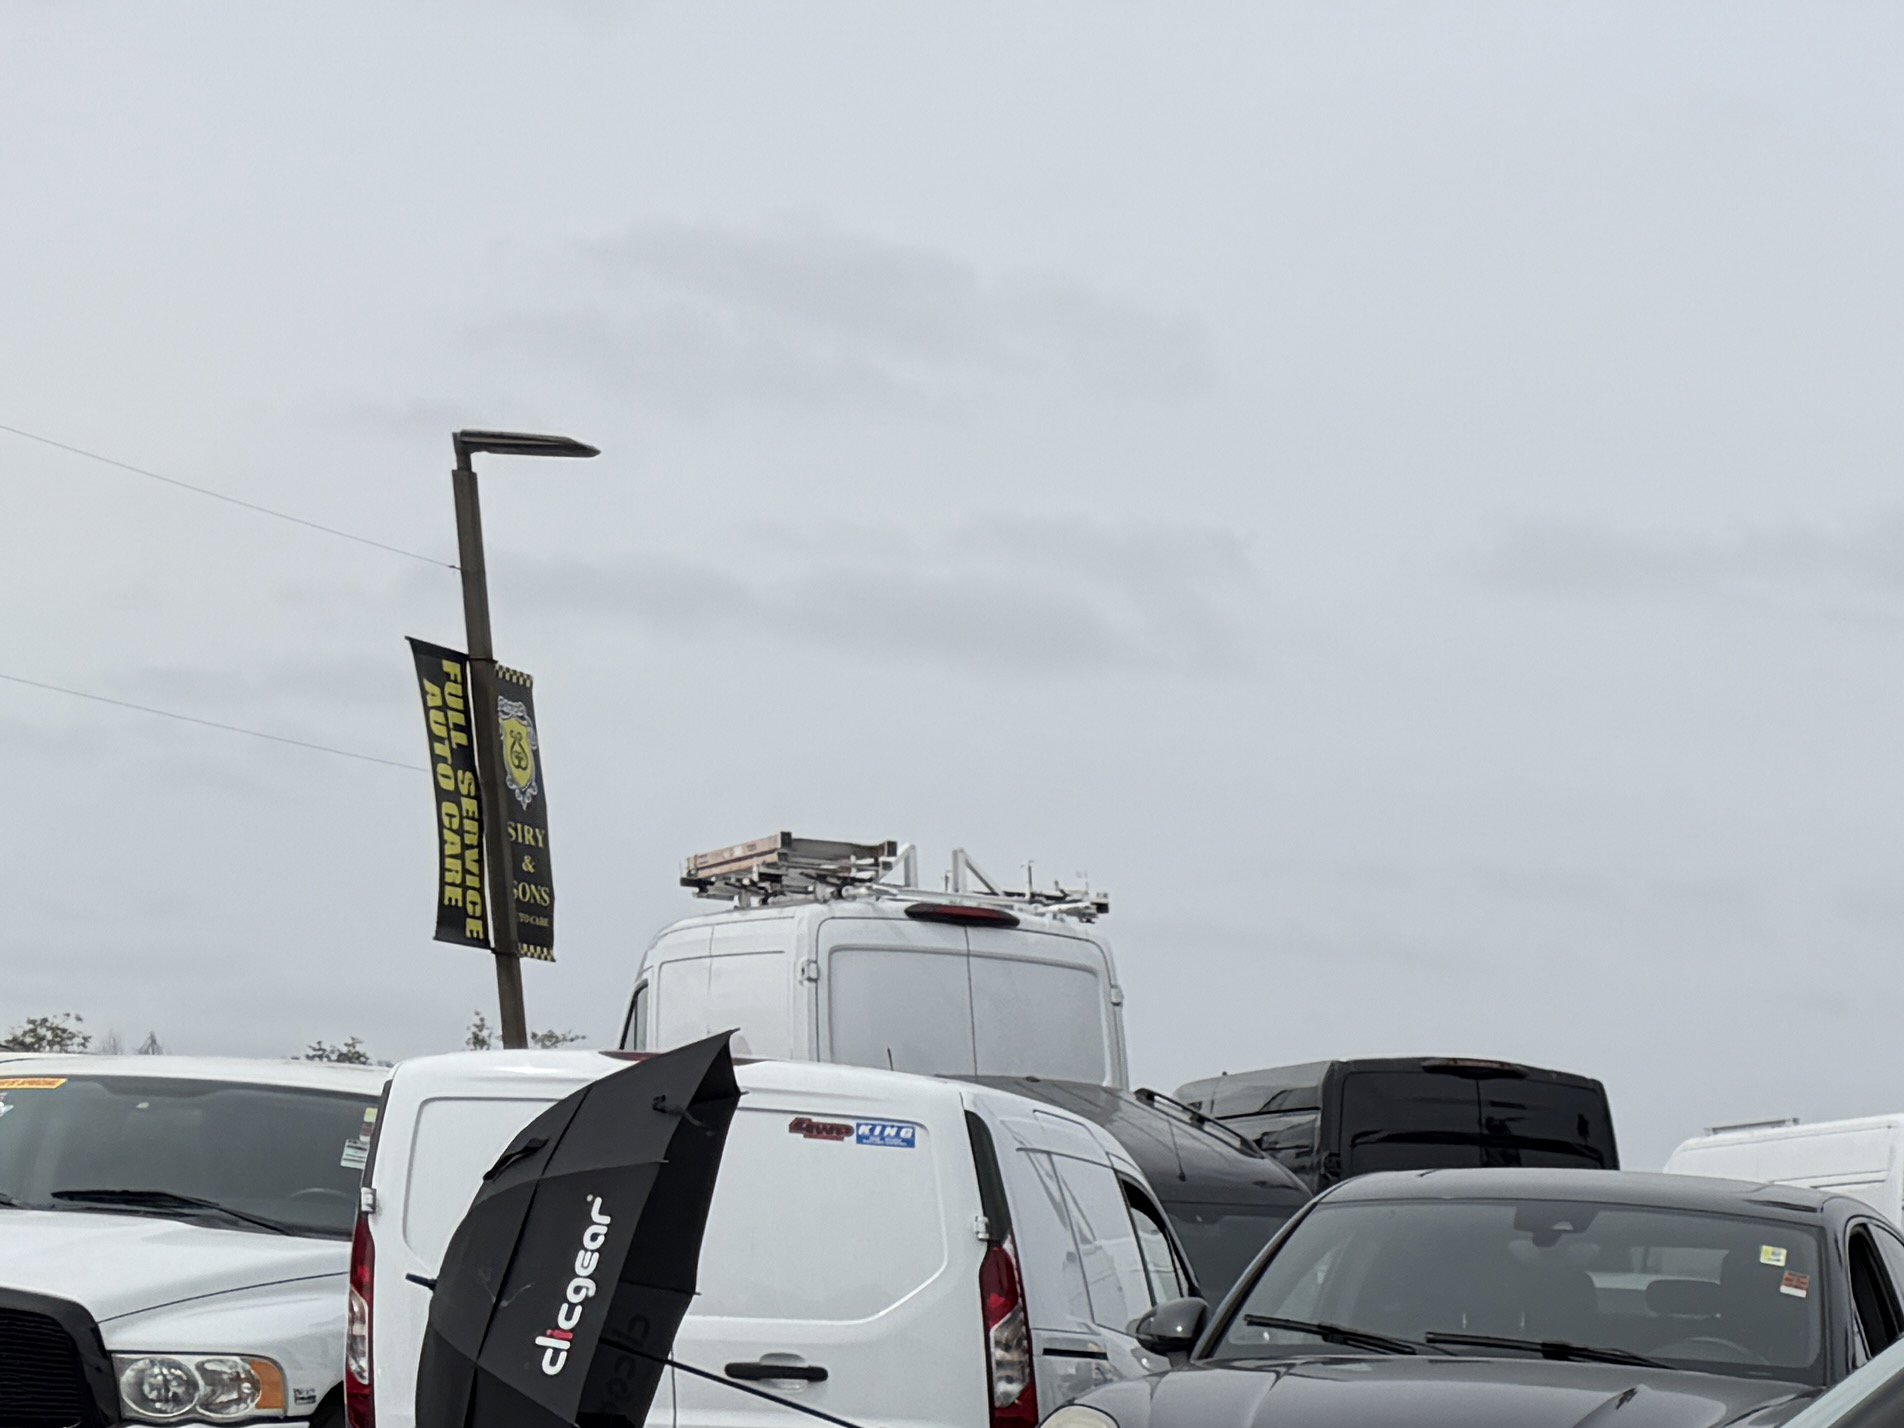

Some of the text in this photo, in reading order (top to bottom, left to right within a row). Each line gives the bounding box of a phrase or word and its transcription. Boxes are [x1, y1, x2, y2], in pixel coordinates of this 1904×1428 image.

[423, 678, 463, 908] AUTO CARE
[442, 659, 484, 940] FULL SERVICE
[506, 821, 545, 848] SIRY
[521, 855, 536, 874] &
[858, 1124, 914, 1139] KING
[535, 1196, 611, 1376] clicgear
